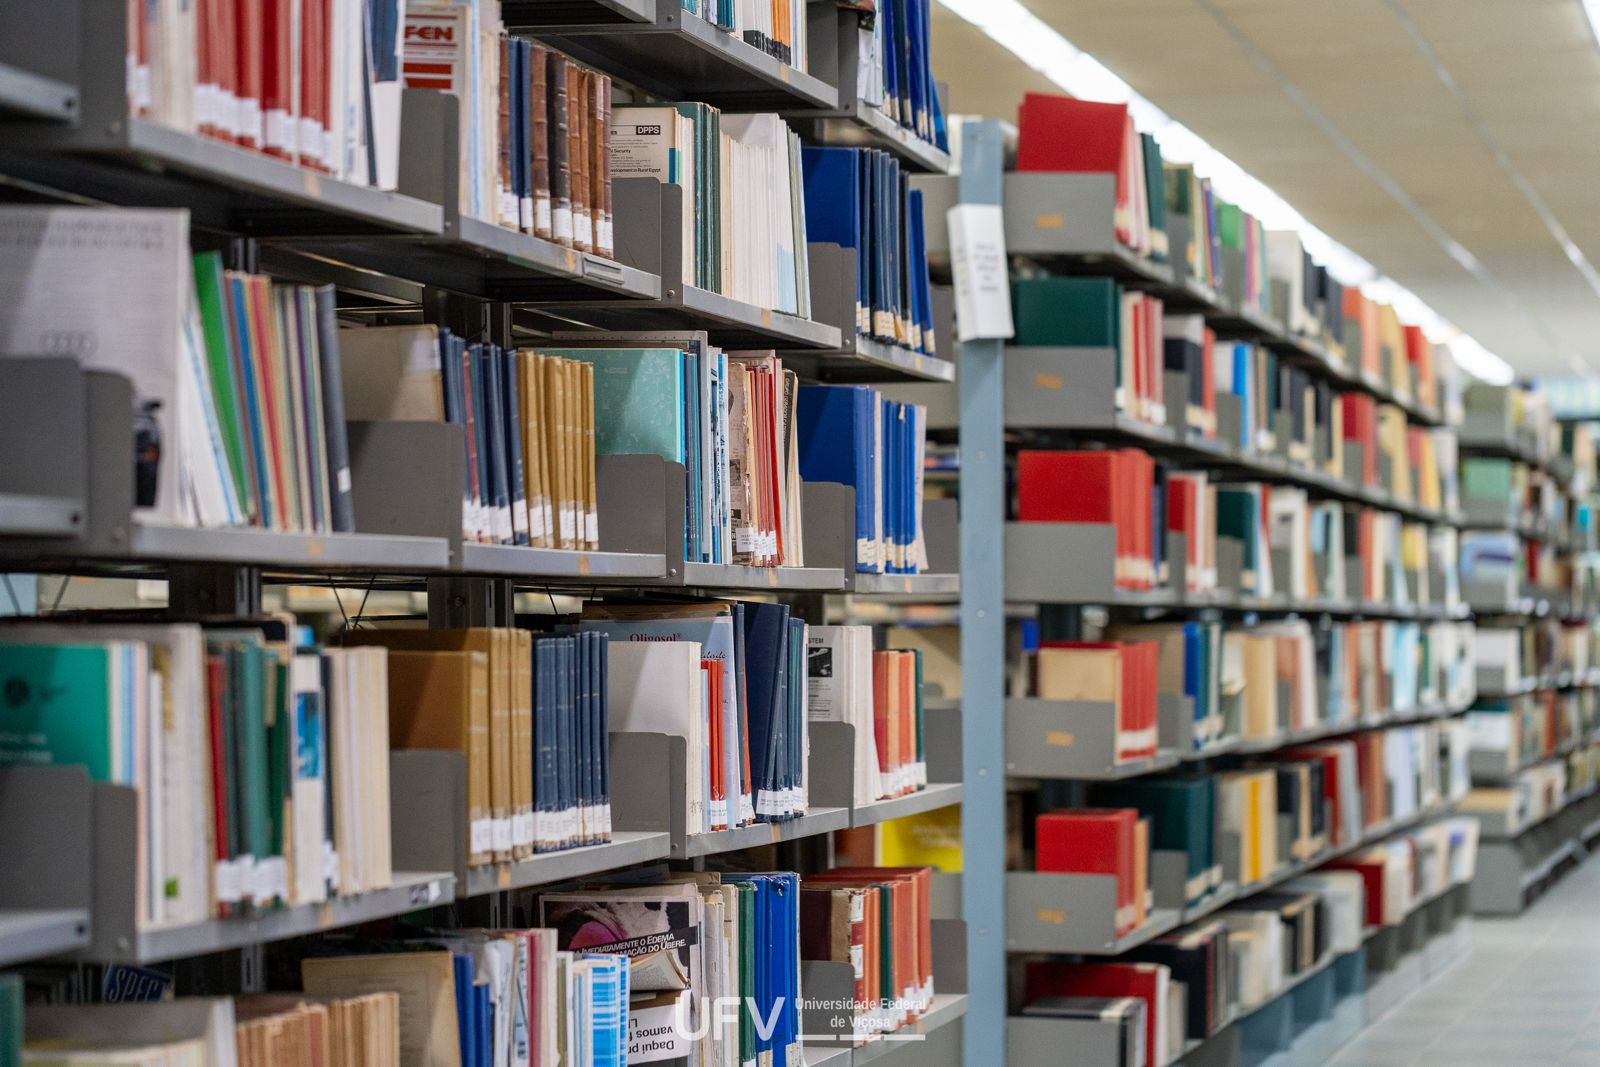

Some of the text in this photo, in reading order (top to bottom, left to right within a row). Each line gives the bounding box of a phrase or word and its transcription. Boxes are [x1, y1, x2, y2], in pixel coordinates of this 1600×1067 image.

[637, 126, 660, 134] DPPS
[647, 933, 675, 945] EDEMA
[648, 944, 660, 953] DO
[636, 1026, 673, 1038] vamos
[642, 1040, 675, 1054] Daqui
